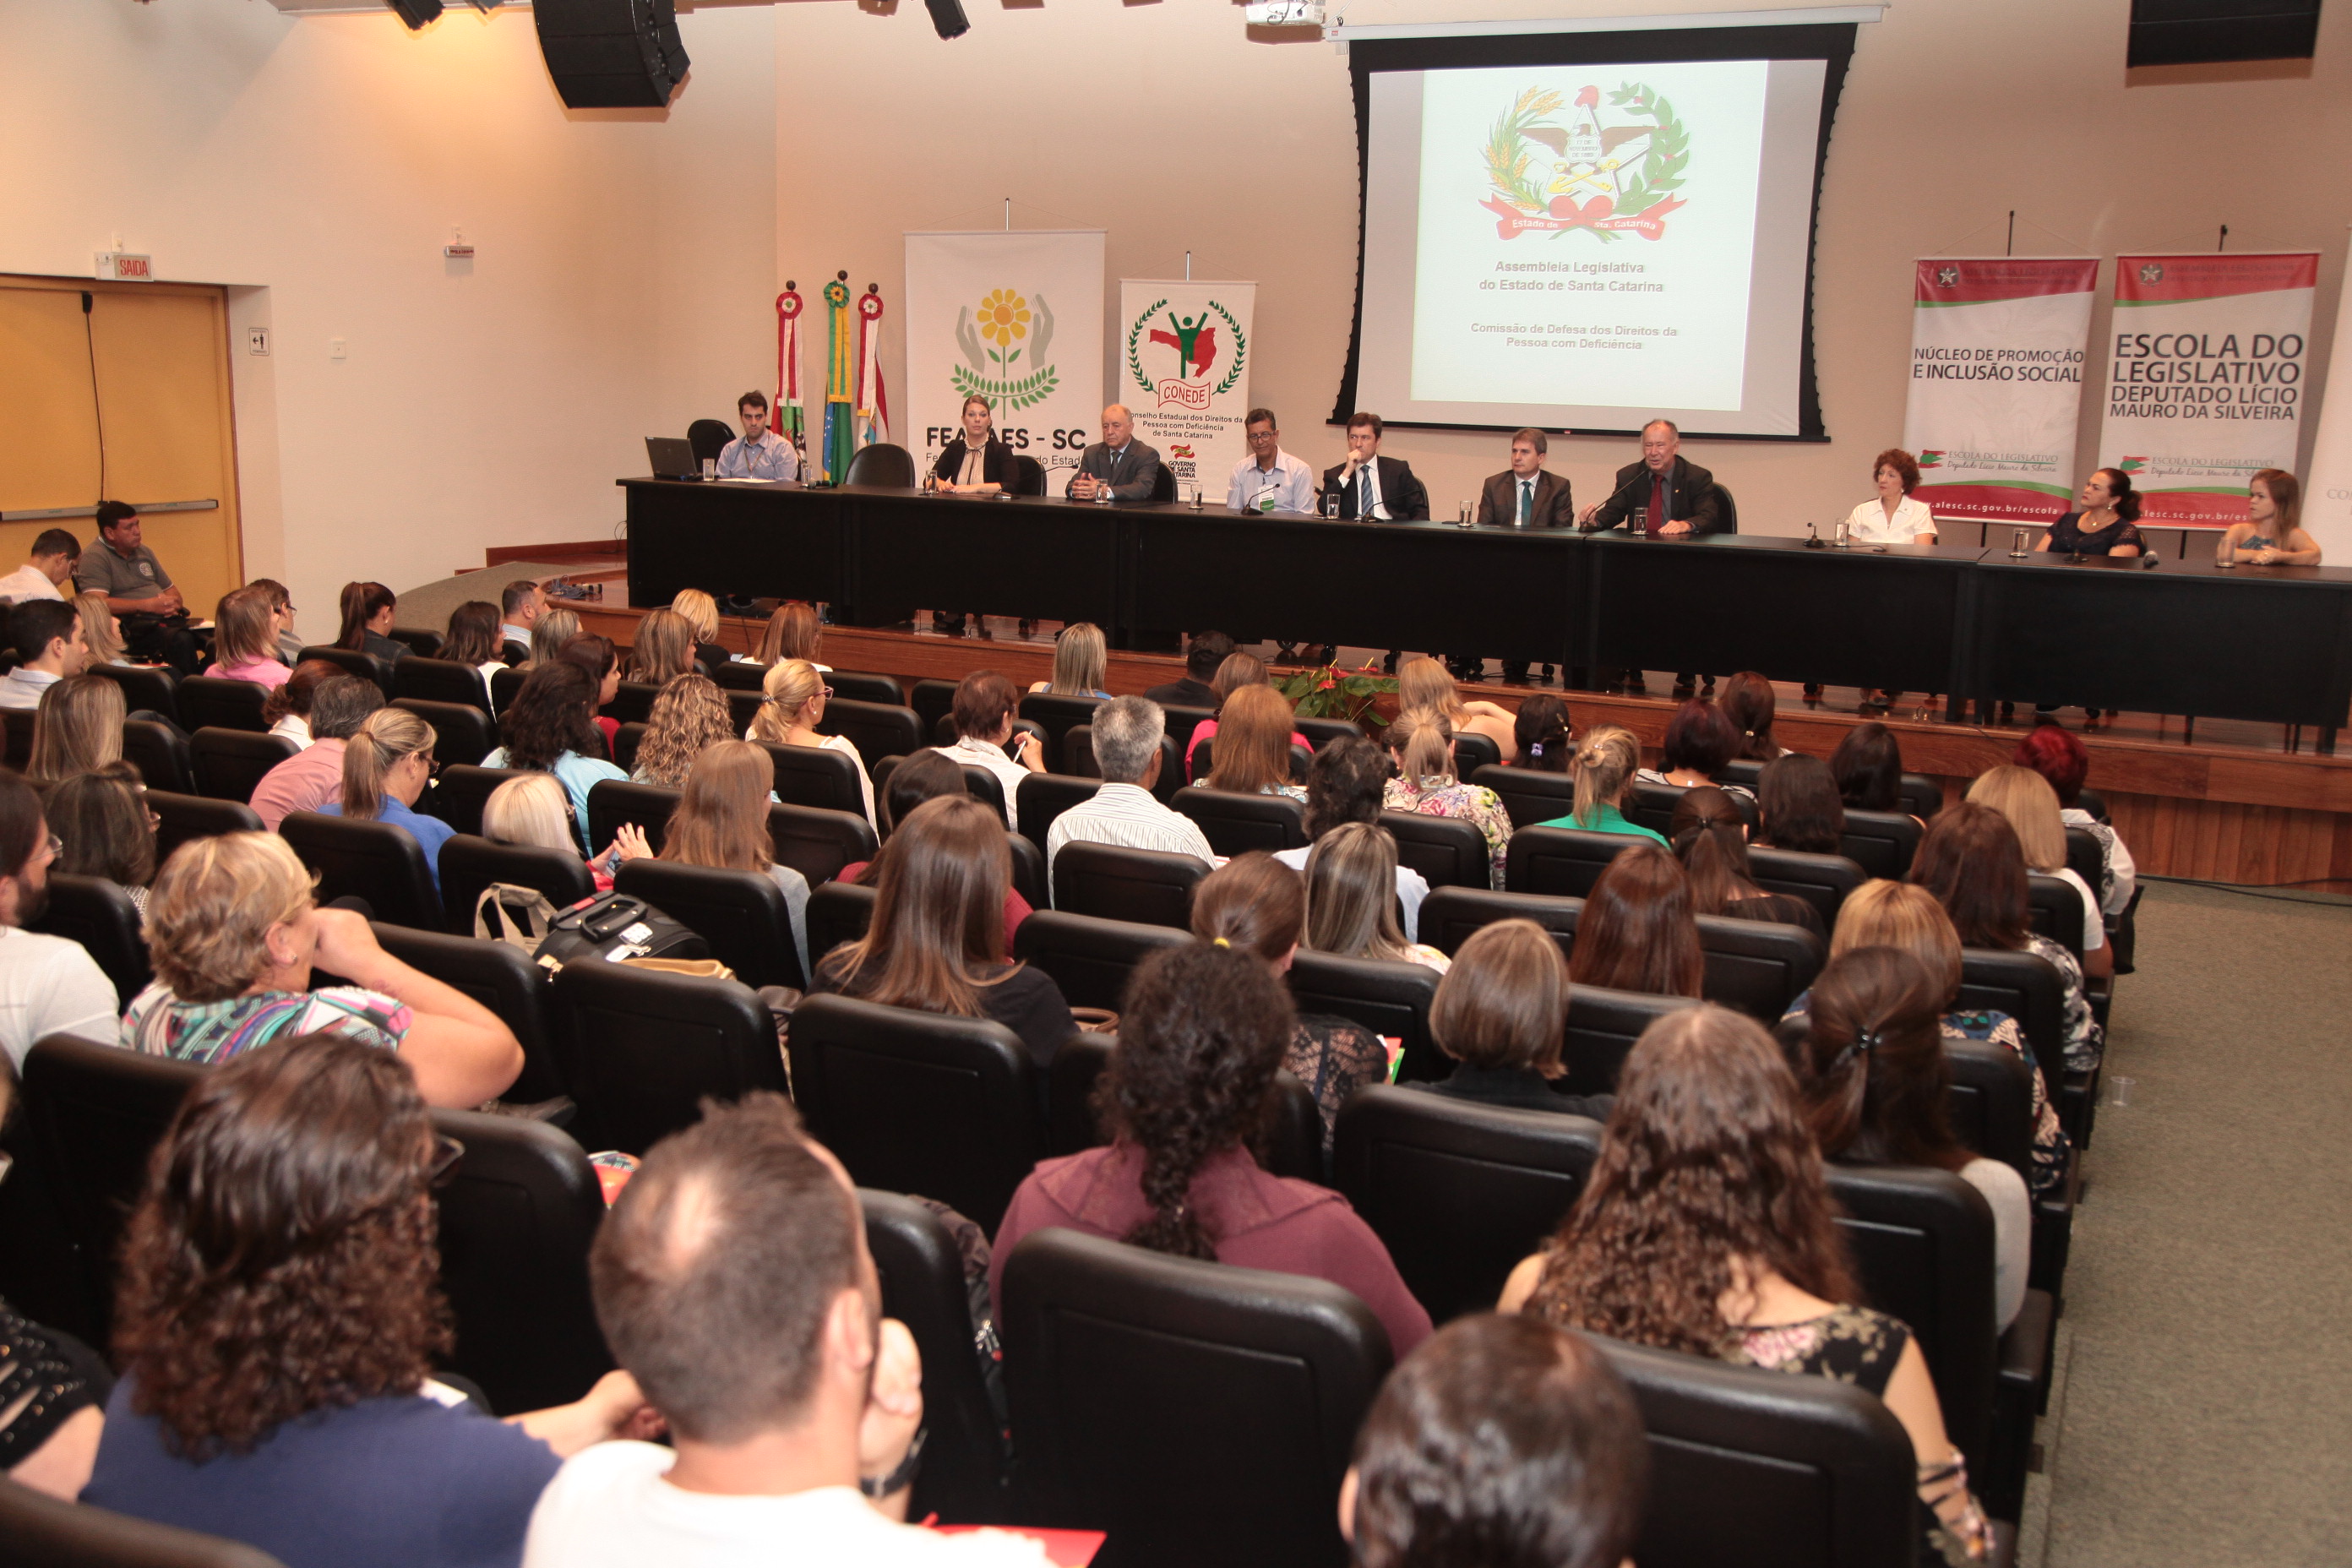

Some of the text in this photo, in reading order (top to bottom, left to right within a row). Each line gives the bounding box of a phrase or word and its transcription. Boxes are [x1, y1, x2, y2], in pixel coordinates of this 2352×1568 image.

[1511, 219, 1544, 228] Estado
[1614, 219, 1656, 230] Catarina
[1494, 260, 1645, 275] Assembleia Legislativa
[1478, 280, 1663, 292] do Estado de Santa Catarina
[1470, 323, 1677, 337] Comissão de Defesa dos Direitos da
[1505, 337, 1642, 350] Pessoa com Deficiência
[2115, 334, 2304, 360] ESCOLA DO
[1914, 346, 2084, 366] NÚCLEO DE PROMOÇÃO
[1913, 362, 2082, 383] E INCLUSÃO SOCIAL
[2113, 361, 2300, 385] LEGISLATIVO
[1163, 385, 1206, 404] CONEDE
[2111, 384, 2298, 405] DEPUTADO LÍCIO
[1158, 412, 1189, 421] Estadual
[2110, 403, 2295, 421] MAURO DA SILVEIRA
[1185, 422, 1224, 431] Deficiência
[1052, 428, 1086, 450] SC
[1051, 455, 1081, 466] Estad
[1948, 451, 2059, 463] ESCOLA DO LEGISLATIVO
[2210, 459, 2274, 467] LEGISLATIVO
